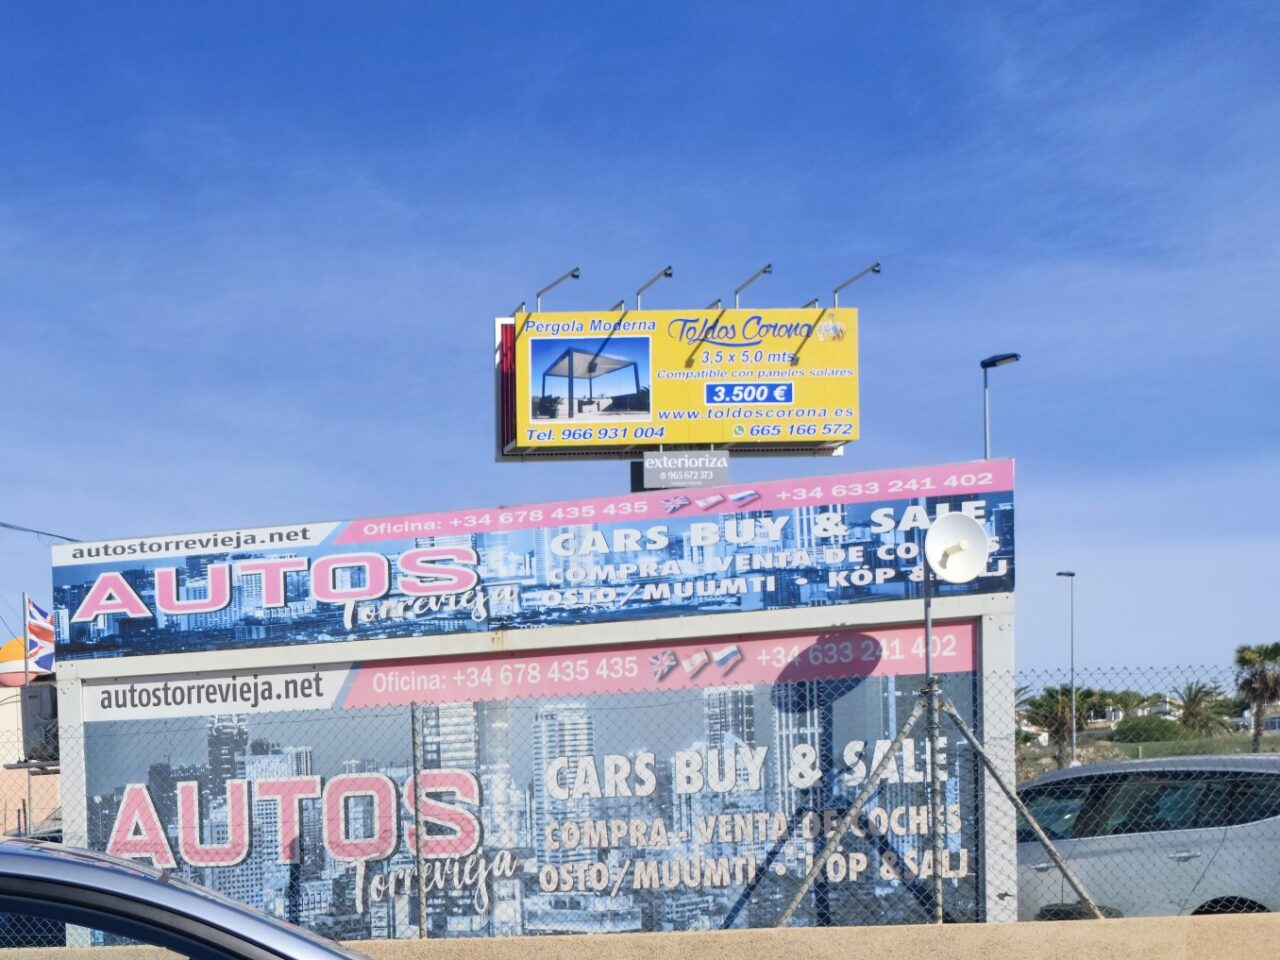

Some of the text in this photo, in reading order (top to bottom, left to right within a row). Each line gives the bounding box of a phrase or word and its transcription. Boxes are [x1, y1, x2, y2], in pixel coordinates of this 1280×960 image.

[590, 319, 656, 332] Moderna
[668, 315, 813, 347] Toldos Corona
[657, 369, 727, 380] Compatible
[757, 368, 805, 379] paneles
[810, 368, 854, 377] solares
[728, 354, 735, 363] x
[713, 385, 788, 401] 3.500 €
[658, 407, 854, 420] www.toldoscorona.es
[750, 423, 853, 436] 665 166 572
[526, 427, 665, 441] Tel. 966 931 004
[644, 454, 728, 469] exterioriza
[667, 471, 683, 480] 965
[363, 473, 993, 536] Oficina: +34 678 435 435 +34 633 241 402
[71, 526, 311, 560] autostorrevieja.net
[551, 525, 669, 557] CARS
[690, 516, 791, 547] BUY
[813, 512, 848, 537] &
[548, 560, 682, 584] COMPRA
[713, 549, 813, 572] VENTA
[826, 546, 865, 564] DE
[829, 565, 896, 588] KÖP
[70, 547, 481, 624] AUTOS
[338, 585, 519, 630] Torrevieja
[373, 634, 957, 693] Oficina: +34 678 435 435 +34 633 241 402
[100, 672, 324, 710] autostorrevieja.net
[546, 736, 949, 800] CARS BUY & SALE
[106, 769, 483, 869] AUTOS
[544, 816, 670, 850] COMPRA
[697, 812, 789, 844] VENTA
[348, 846, 519, 914] Torrevieja
[880, 850, 901, 881] &
